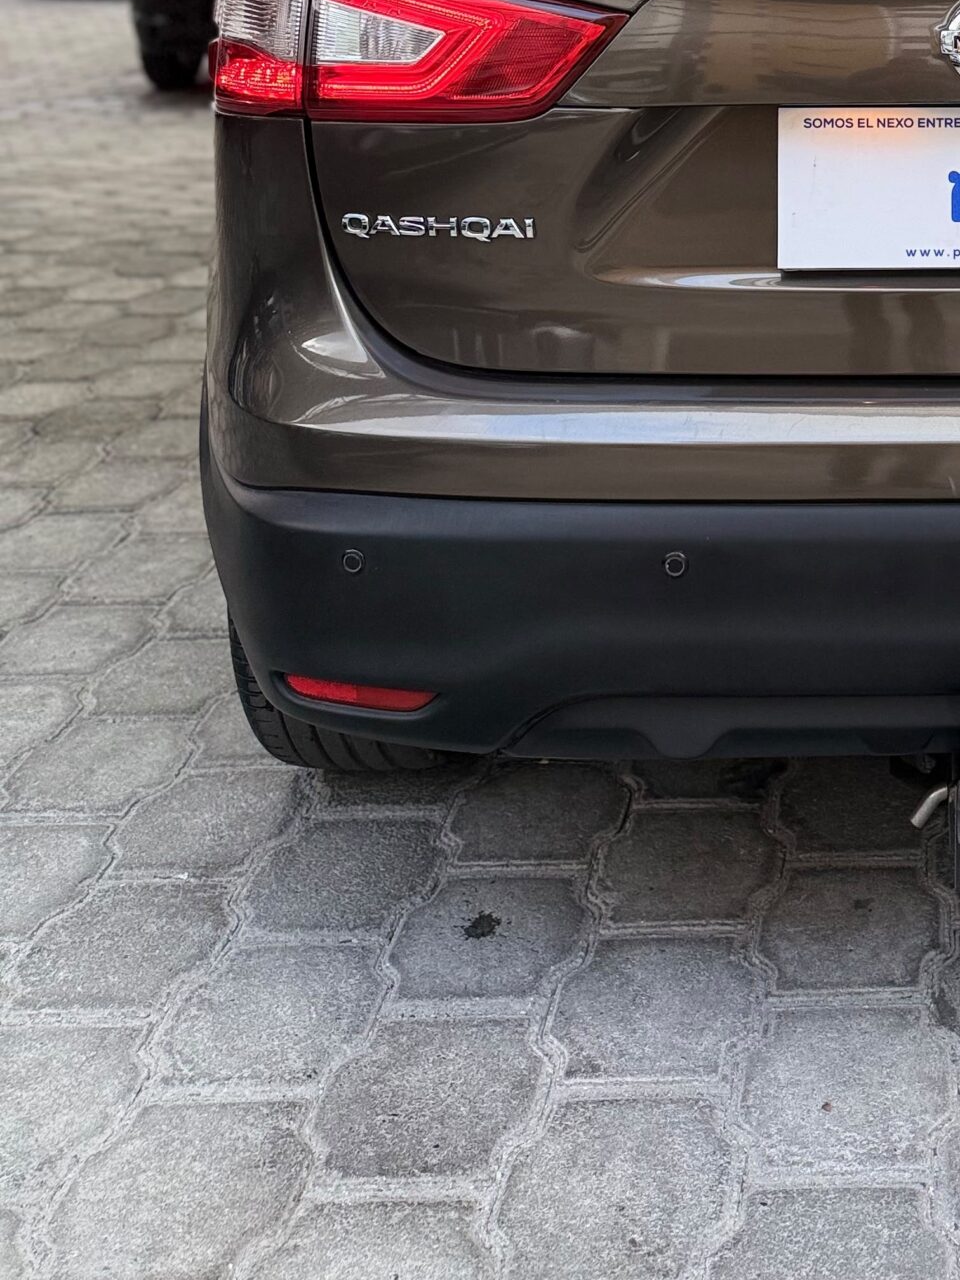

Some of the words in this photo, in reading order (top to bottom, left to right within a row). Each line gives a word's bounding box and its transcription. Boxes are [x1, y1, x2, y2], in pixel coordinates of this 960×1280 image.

[803, 117, 854, 129] SOMOS
[857, 117, 874, 129] EL
[876, 117, 914, 129] NEXO
[341, 212, 535, 243] QASHQAI
